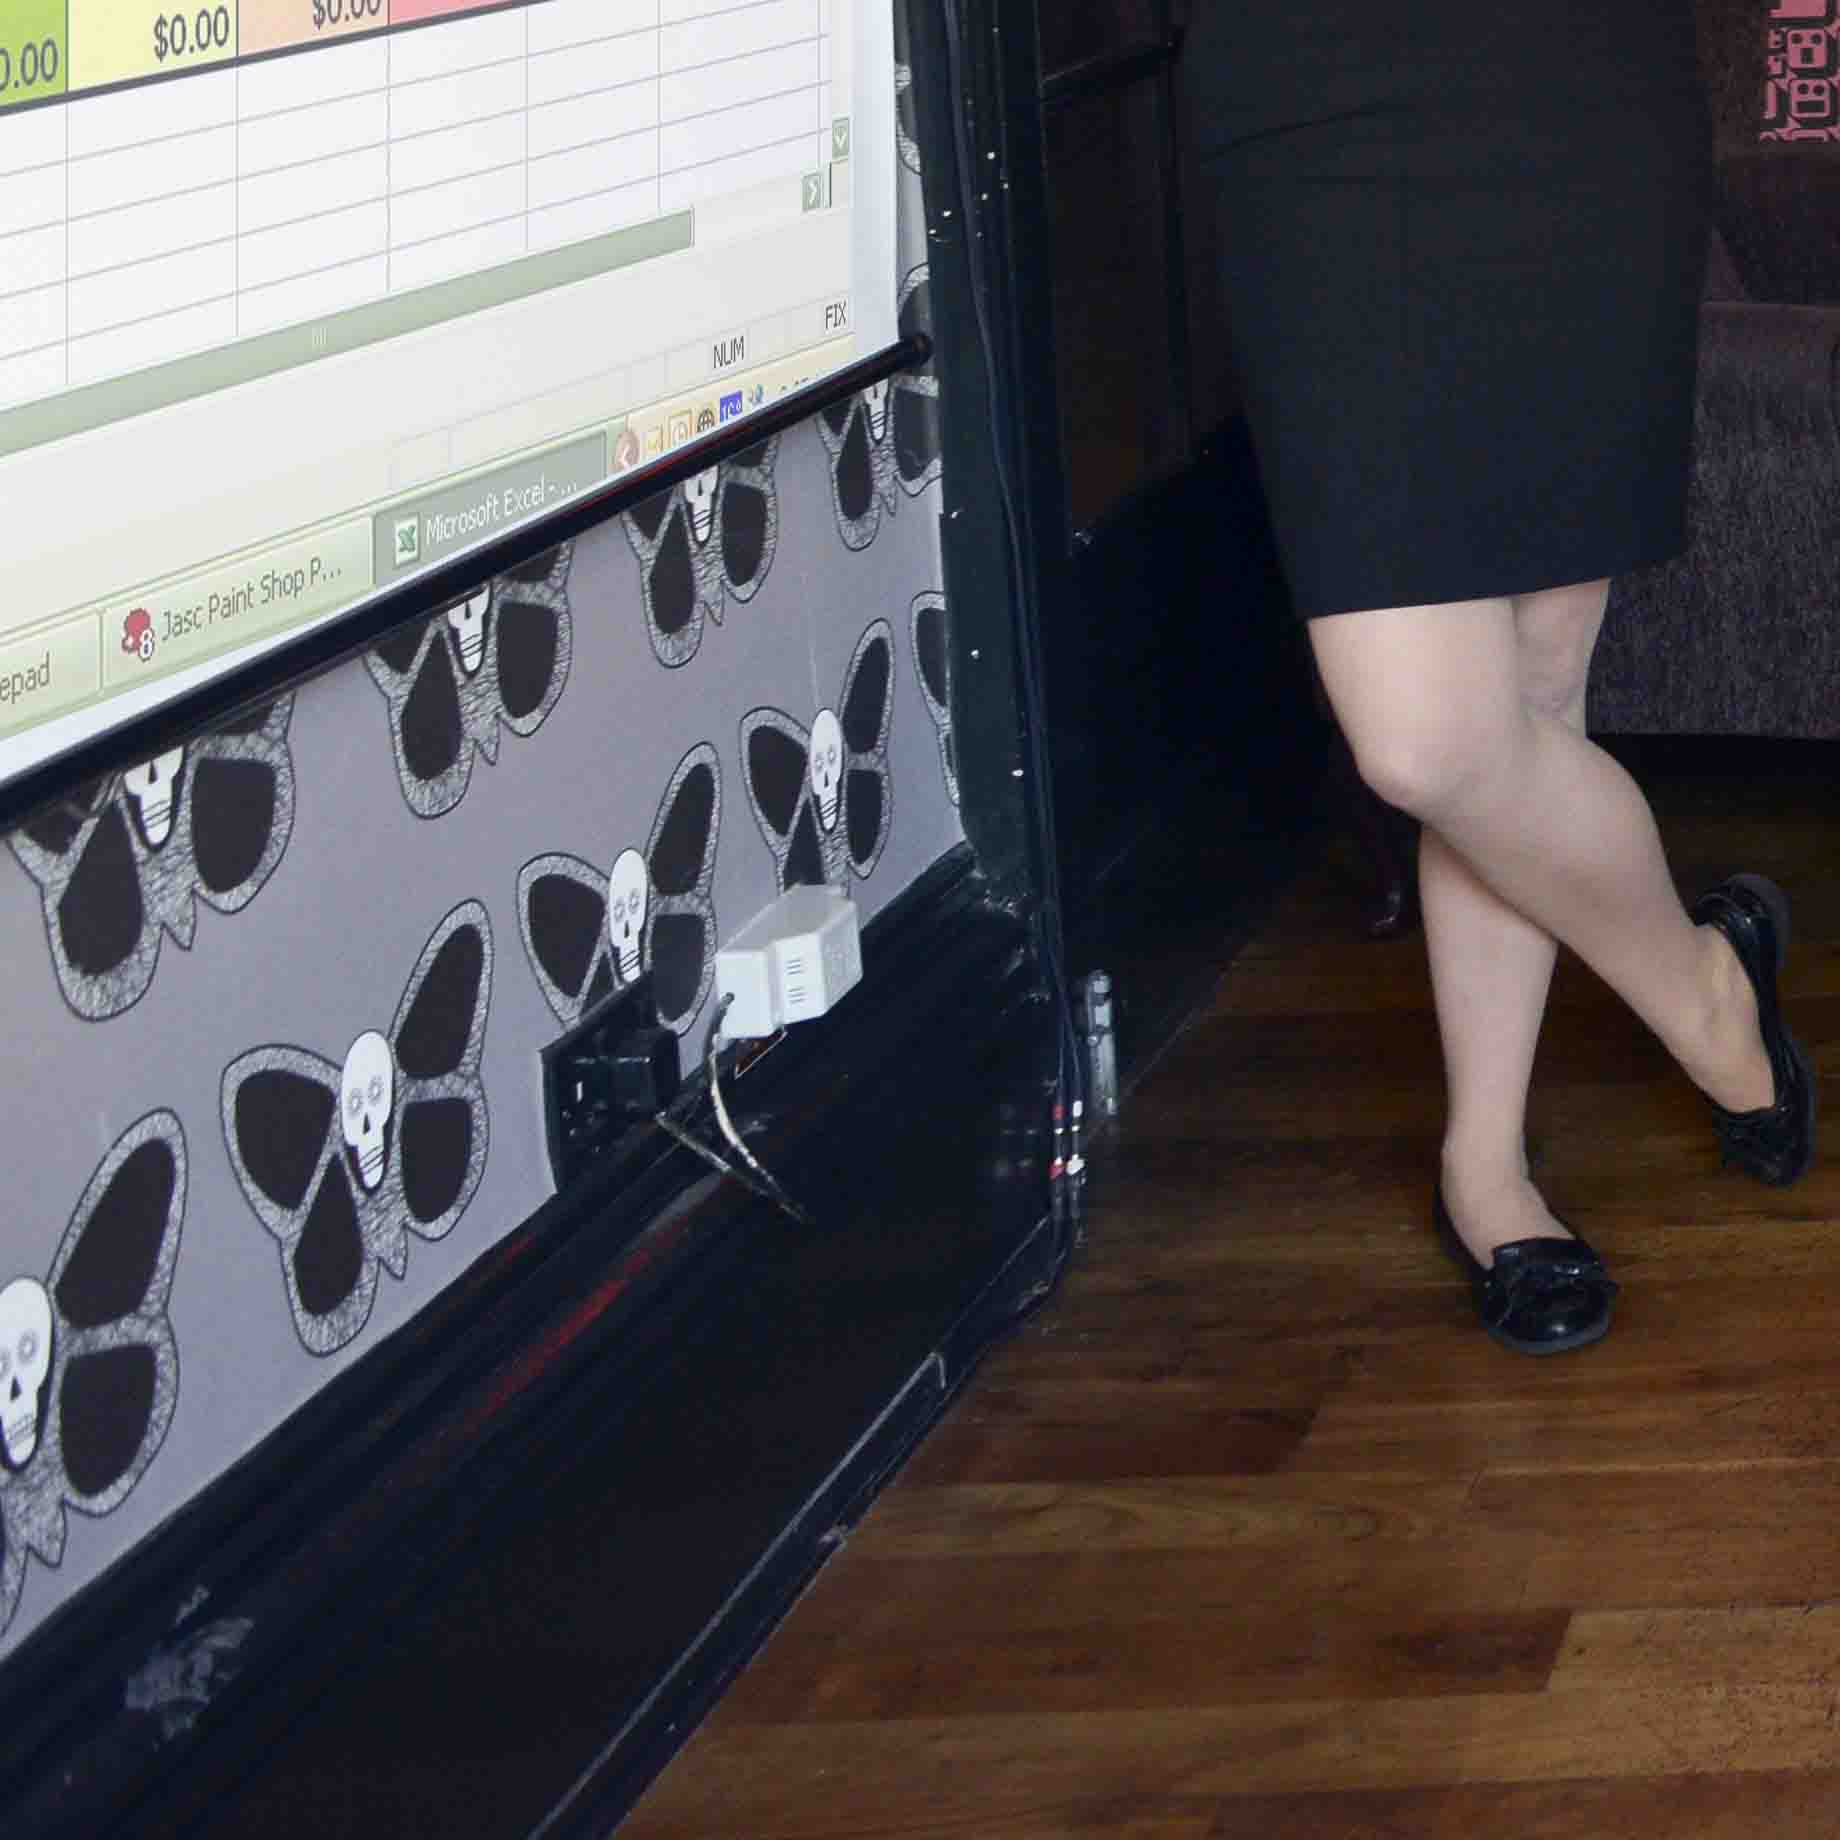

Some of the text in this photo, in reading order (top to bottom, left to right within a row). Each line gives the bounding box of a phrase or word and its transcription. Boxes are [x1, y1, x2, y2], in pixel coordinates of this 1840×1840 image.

[153, 5, 230, 60] $0.00
[825, 300, 847, 329] FIX
[713, 335, 745, 368] NUM
[426, 492, 500, 545] Microsoft
[504, 473, 545, 516] Excel
[161, 605, 204, 641] Jasc
[208, 581, 256, 625] Paint
[260, 566, 305, 604] Shop
